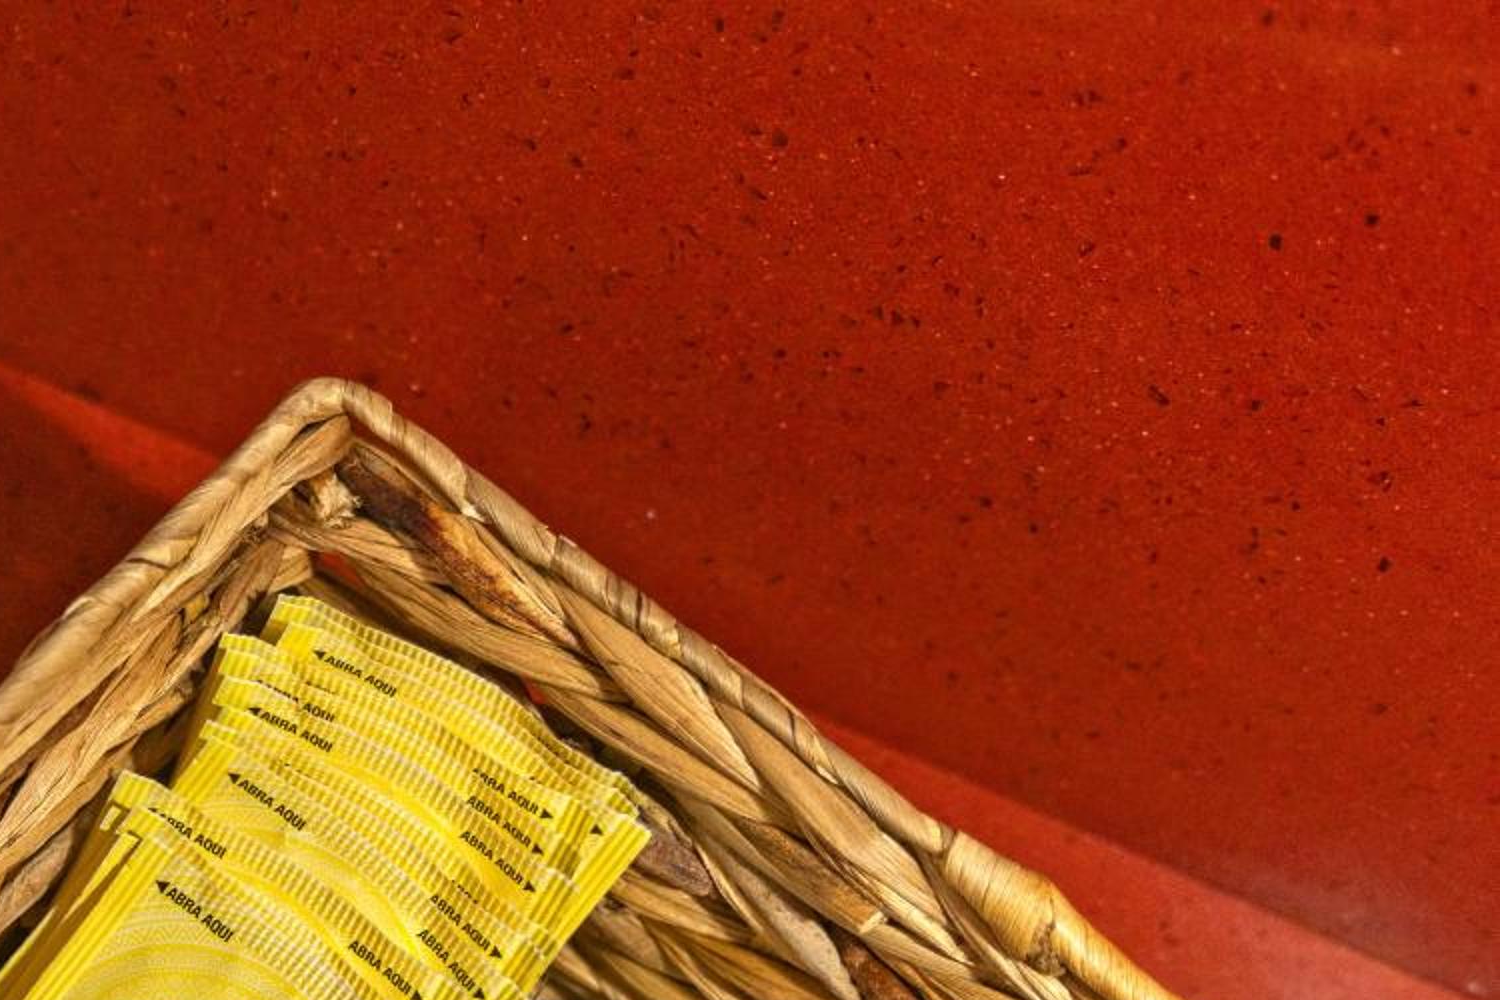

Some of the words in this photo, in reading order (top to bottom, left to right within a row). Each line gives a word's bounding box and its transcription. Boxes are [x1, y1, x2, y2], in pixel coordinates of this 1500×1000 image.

[324, 656, 363, 678] ABRA
[259, 711, 297, 734] ABRA
[238, 780, 273, 808] ABRA
[466, 796, 501, 824] ABRA
[460, 831, 493, 860] ABRA
[166, 887, 201, 918] ABRA
[431, 895, 461, 925] ABRA
[348, 940, 381, 970] ABRA
[417, 929, 450, 963] ABRA
